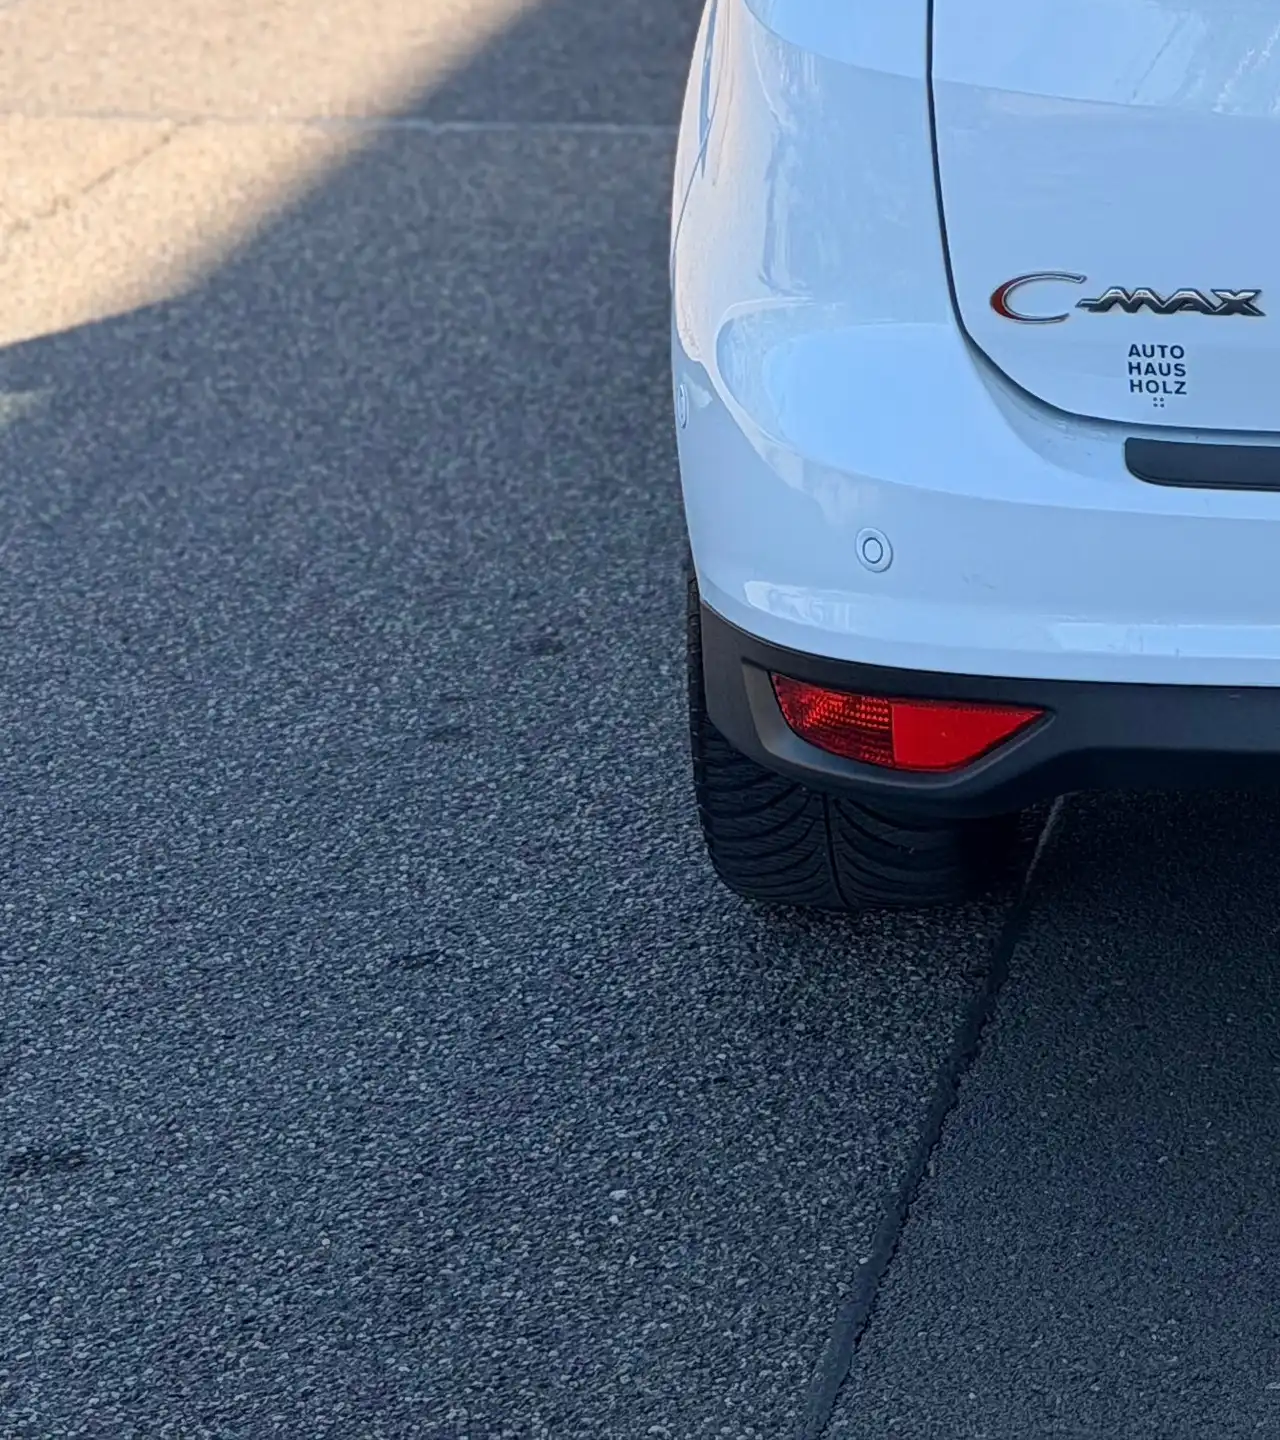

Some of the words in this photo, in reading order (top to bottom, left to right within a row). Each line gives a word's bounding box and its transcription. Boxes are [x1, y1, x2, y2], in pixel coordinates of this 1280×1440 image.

[1127, 343, 1186, 360] AUTO
[1127, 361, 1187, 378] HAUS
[1129, 379, 1188, 396] HOLZ
